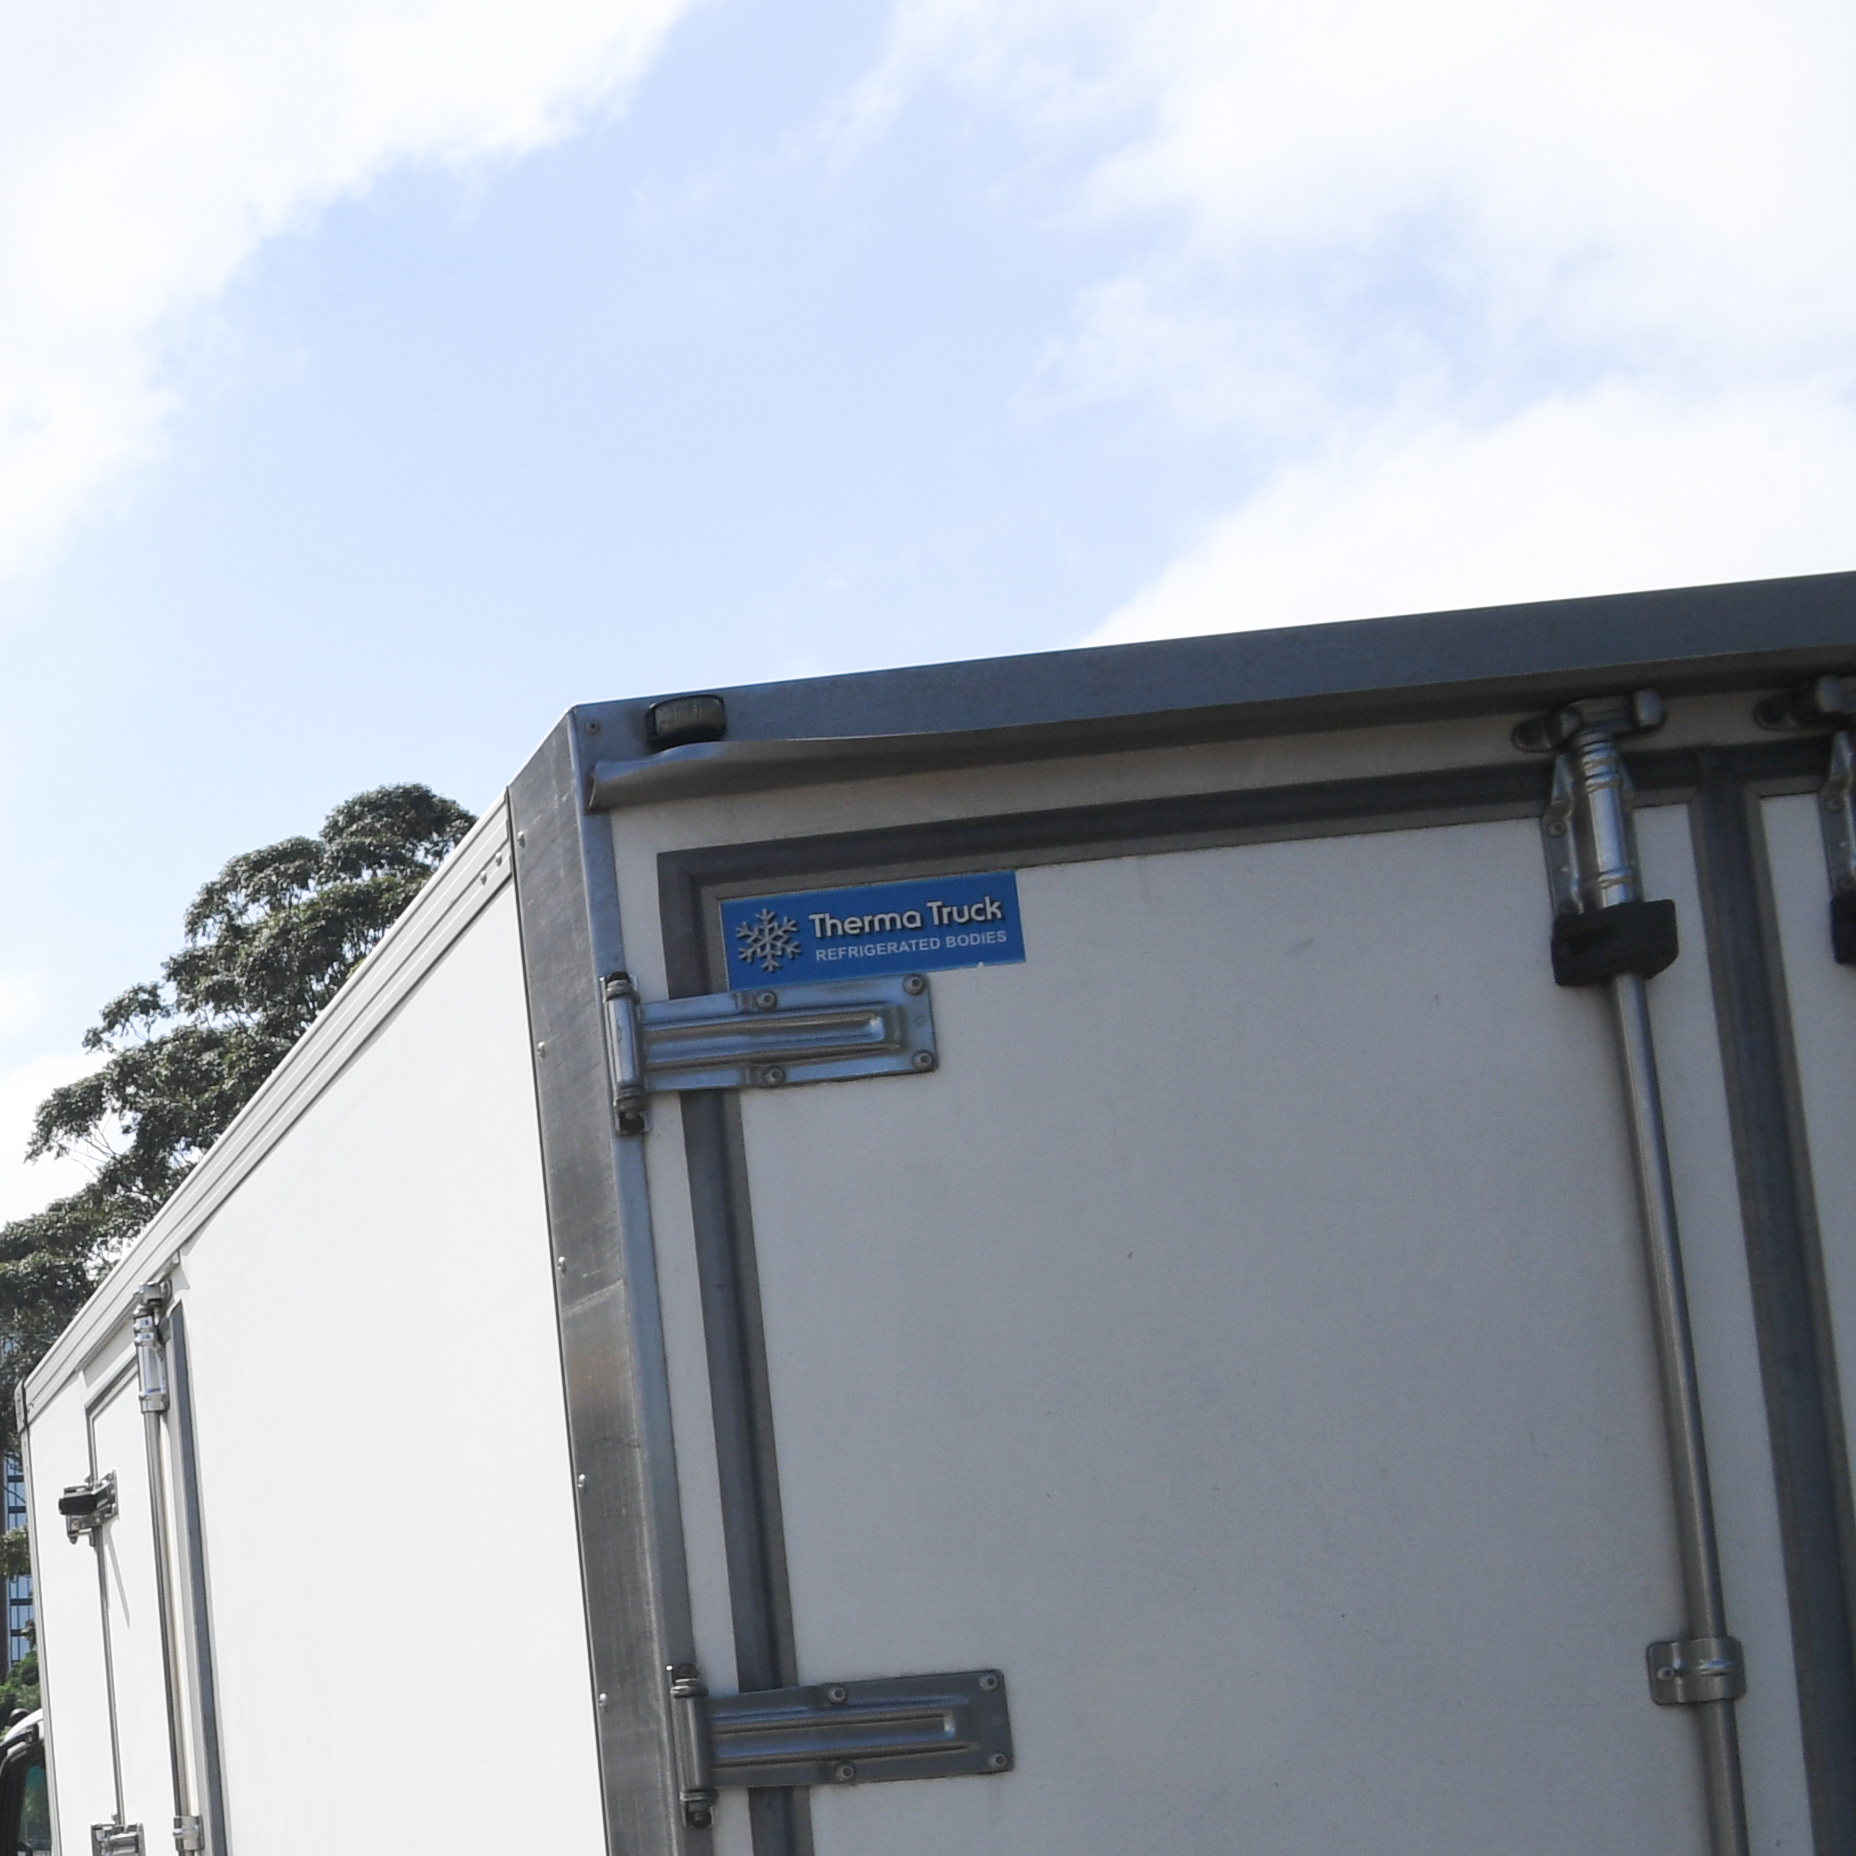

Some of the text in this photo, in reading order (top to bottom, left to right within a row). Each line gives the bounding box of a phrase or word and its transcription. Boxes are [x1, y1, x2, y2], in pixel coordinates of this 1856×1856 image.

[808, 896, 1003, 939] Therma Truck
[816, 930, 1007, 962] REFRIGERATED BODIES
